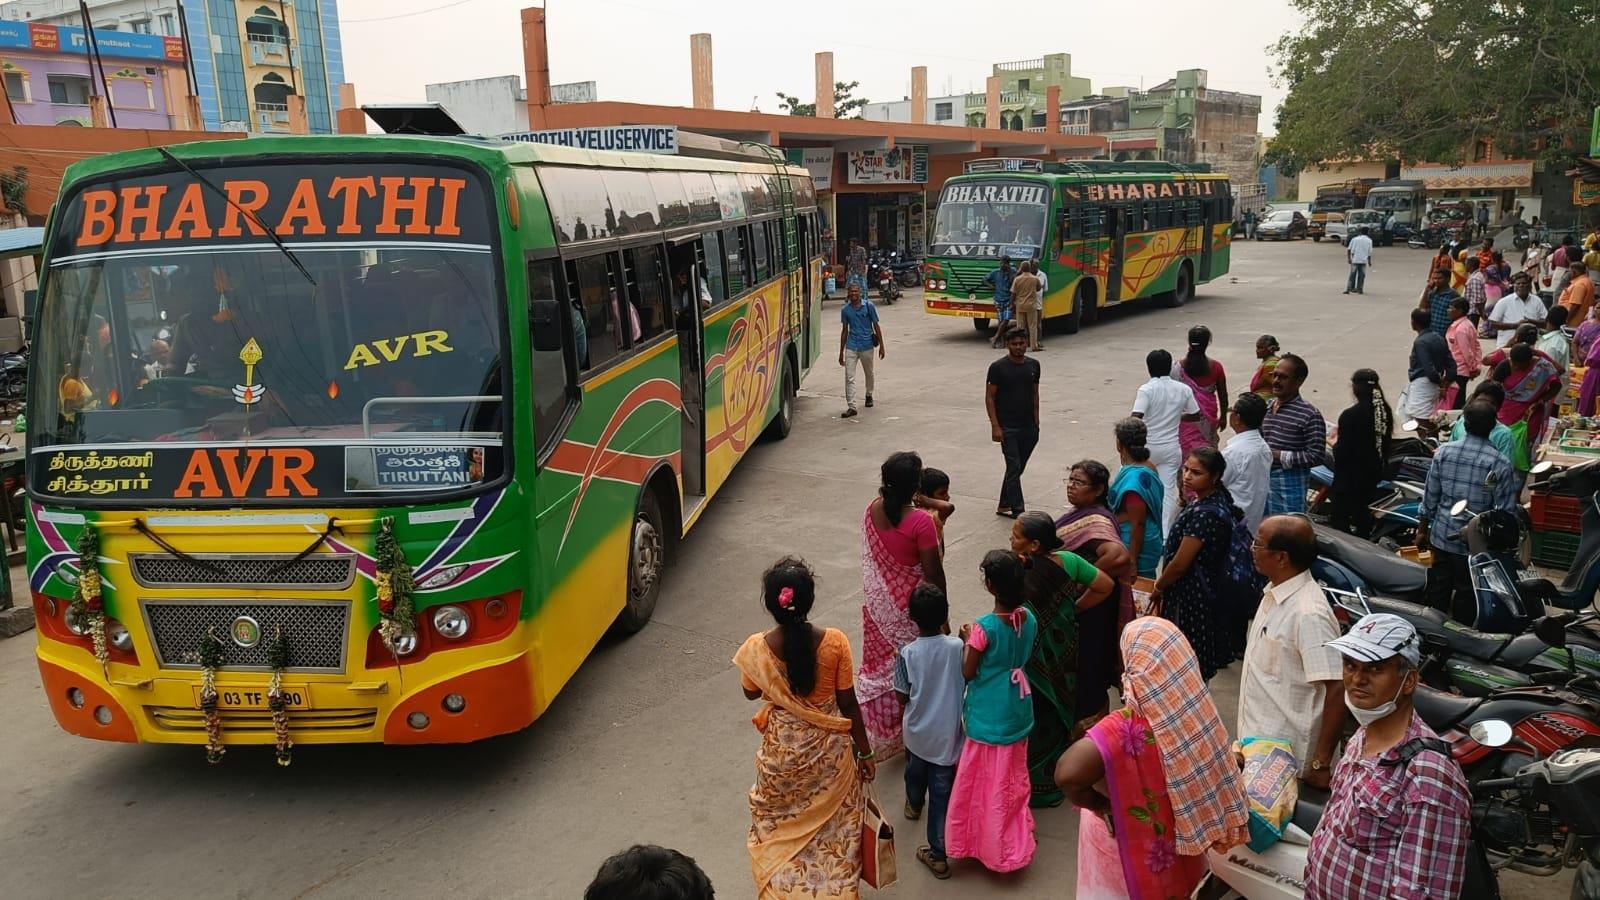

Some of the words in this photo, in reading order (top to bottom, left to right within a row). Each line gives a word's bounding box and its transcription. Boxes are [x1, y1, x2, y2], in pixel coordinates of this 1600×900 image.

[502, 131, 573, 147] ATHI
[865, 156, 883, 168] STAR
[946, 186, 1045, 202] BHARATHI
[1087, 181, 1212, 201] BHARATHI
[76, 175, 466, 247] BHARATHI
[942, 245, 997, 256] AVR
[343, 330, 454, 370] AVR
[48, 451, 153, 471] திருத்தணி
[174, 449, 318, 498] AVR
[380, 471, 470, 483] TIRUTTANI
[223, 691, 241, 705] 03
[244, 692, 261, 705] TF
